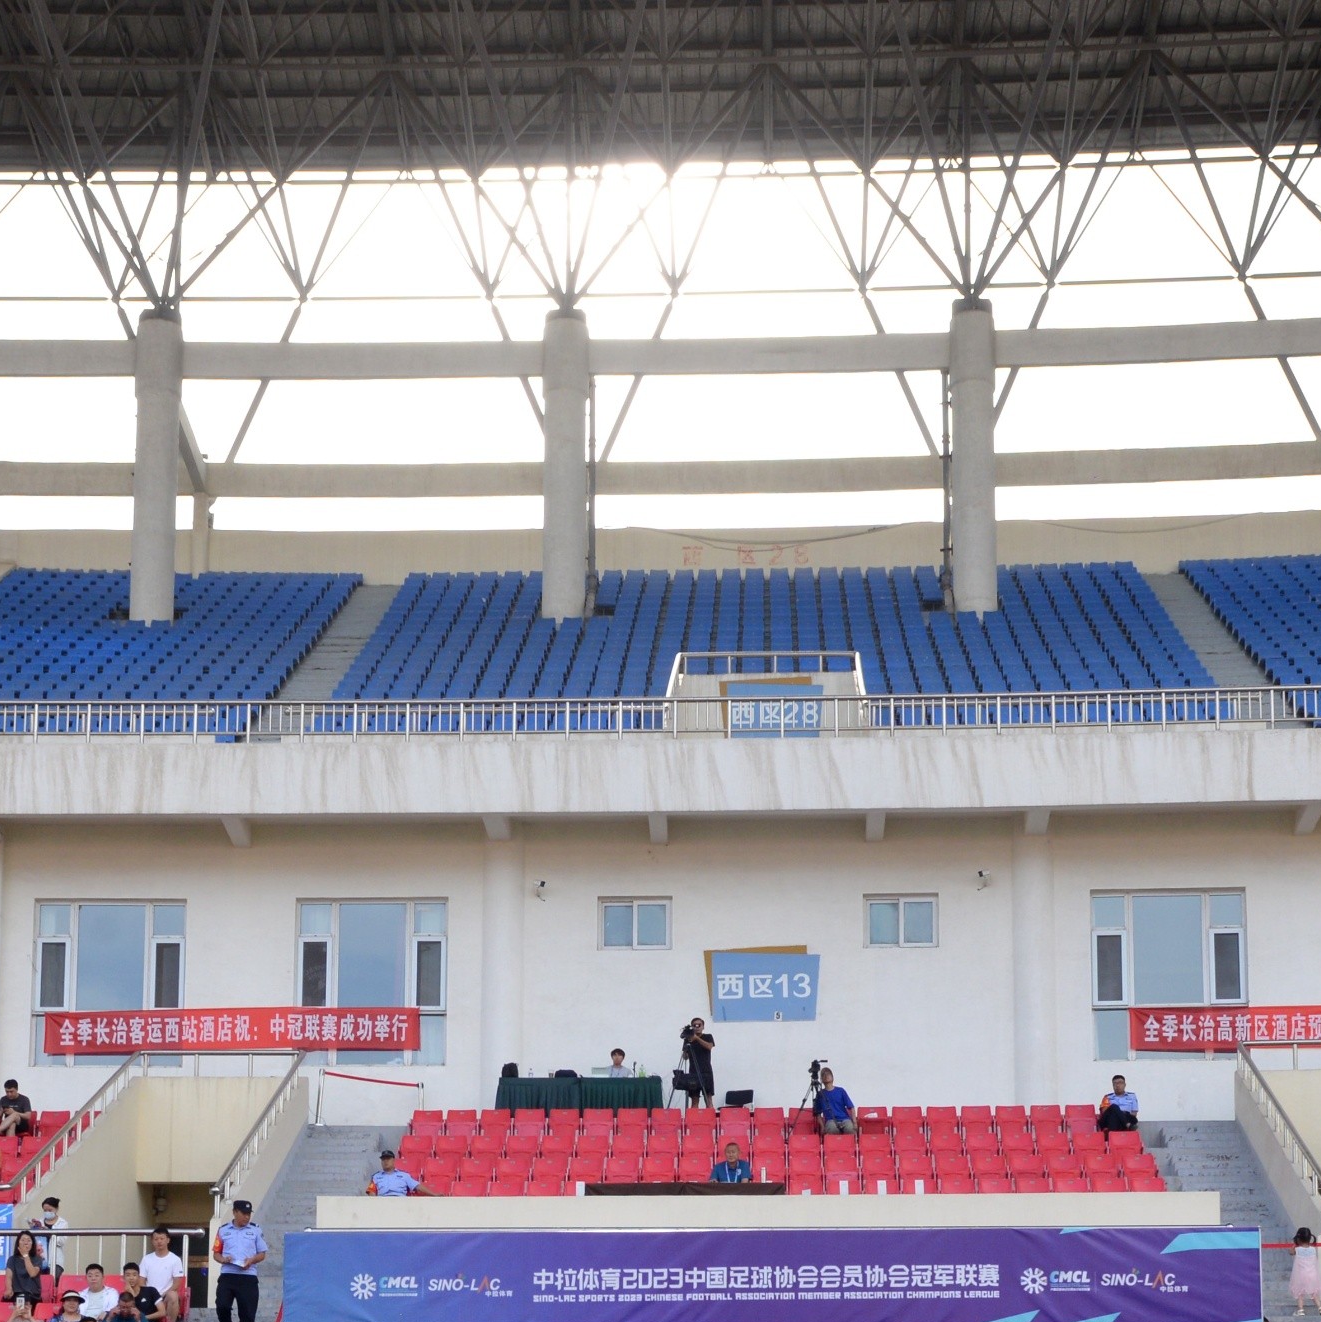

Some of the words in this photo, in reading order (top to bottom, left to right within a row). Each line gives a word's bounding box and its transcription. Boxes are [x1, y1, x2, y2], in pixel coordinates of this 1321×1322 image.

[732, 702, 819, 724] 西区28
[717, 973, 811, 999] 西区13
[380, 1277, 419, 1289] CMCL
[428, 1275, 501, 1293] SINO-LAC
[533, 1264, 1000, 1291] 中拉体育2023中国足球协会会员协会冠军联赛
[1050, 1271, 1091, 1283] CMCL
[1101, 1271, 1176, 1288] SINO-LAC
[579, 1294, 616, 1302] SPORTS
[618, 1294, 643, 1302] 2023
[645, 1293, 684, 1302] CHINESE
[686, 1292, 732, 1301] FOOTBALL
[735, 1292, 795, 1300] ASSOCIATION
[798, 1292, 841, 1300] MEMBER
[844, 1291, 904, 1300] ASSOCIATION
[907, 1290, 961, 1299] CHAMPIONS
[964, 1290, 1000, 1299] LEAGUE
